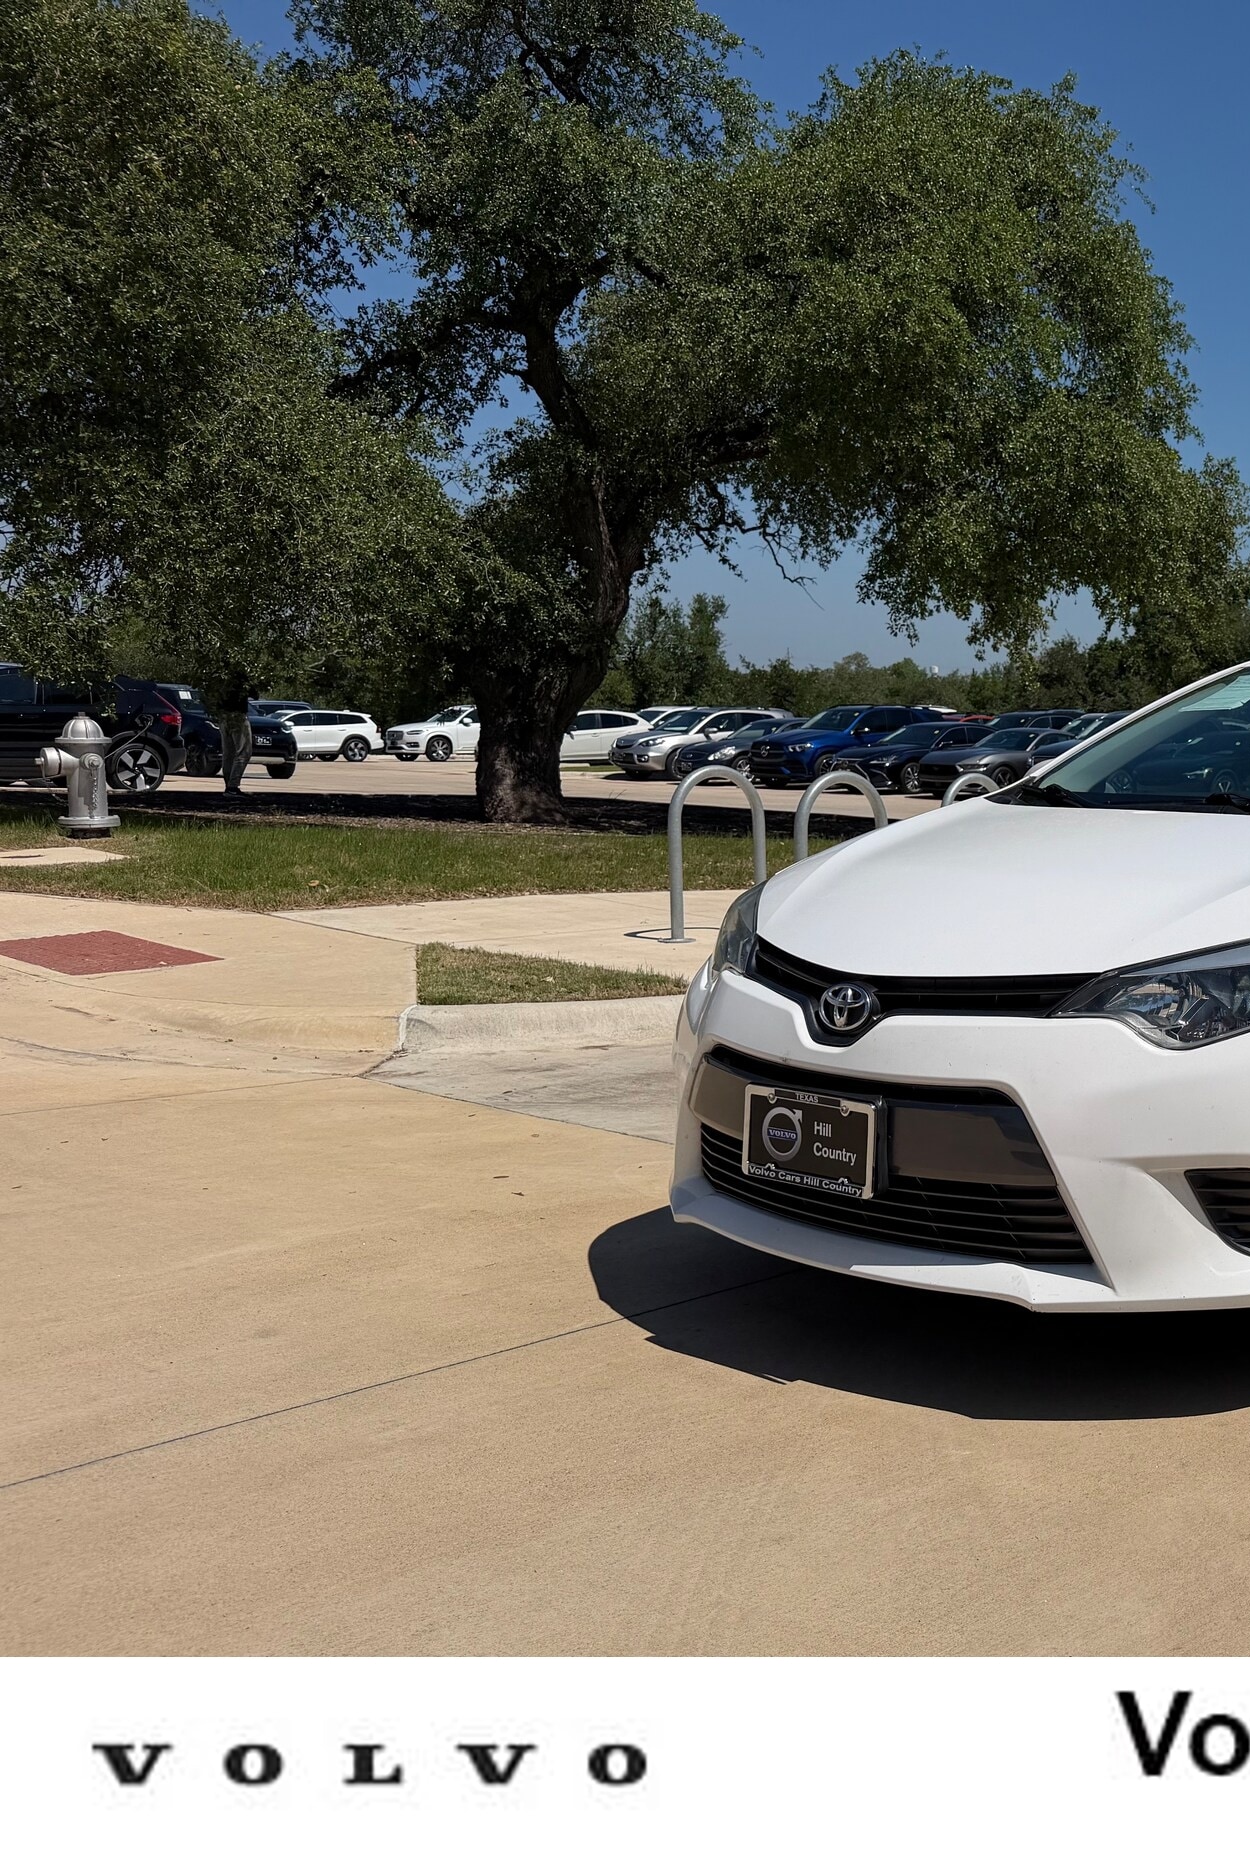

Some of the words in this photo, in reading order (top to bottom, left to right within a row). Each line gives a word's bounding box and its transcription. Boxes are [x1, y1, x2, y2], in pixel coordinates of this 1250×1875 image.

[795, 1092, 819, 1103] TEXAS
[769, 1128, 797, 1140] VOLVO
[813, 1121, 832, 1138] Hill
[813, 1142, 857, 1166] Country
[749, 1165, 776, 1178] Volvo
[778, 1171, 801, 1183] Cars
[803, 1176, 820, 1187] Hill
[822, 1181, 862, 1197] Country
